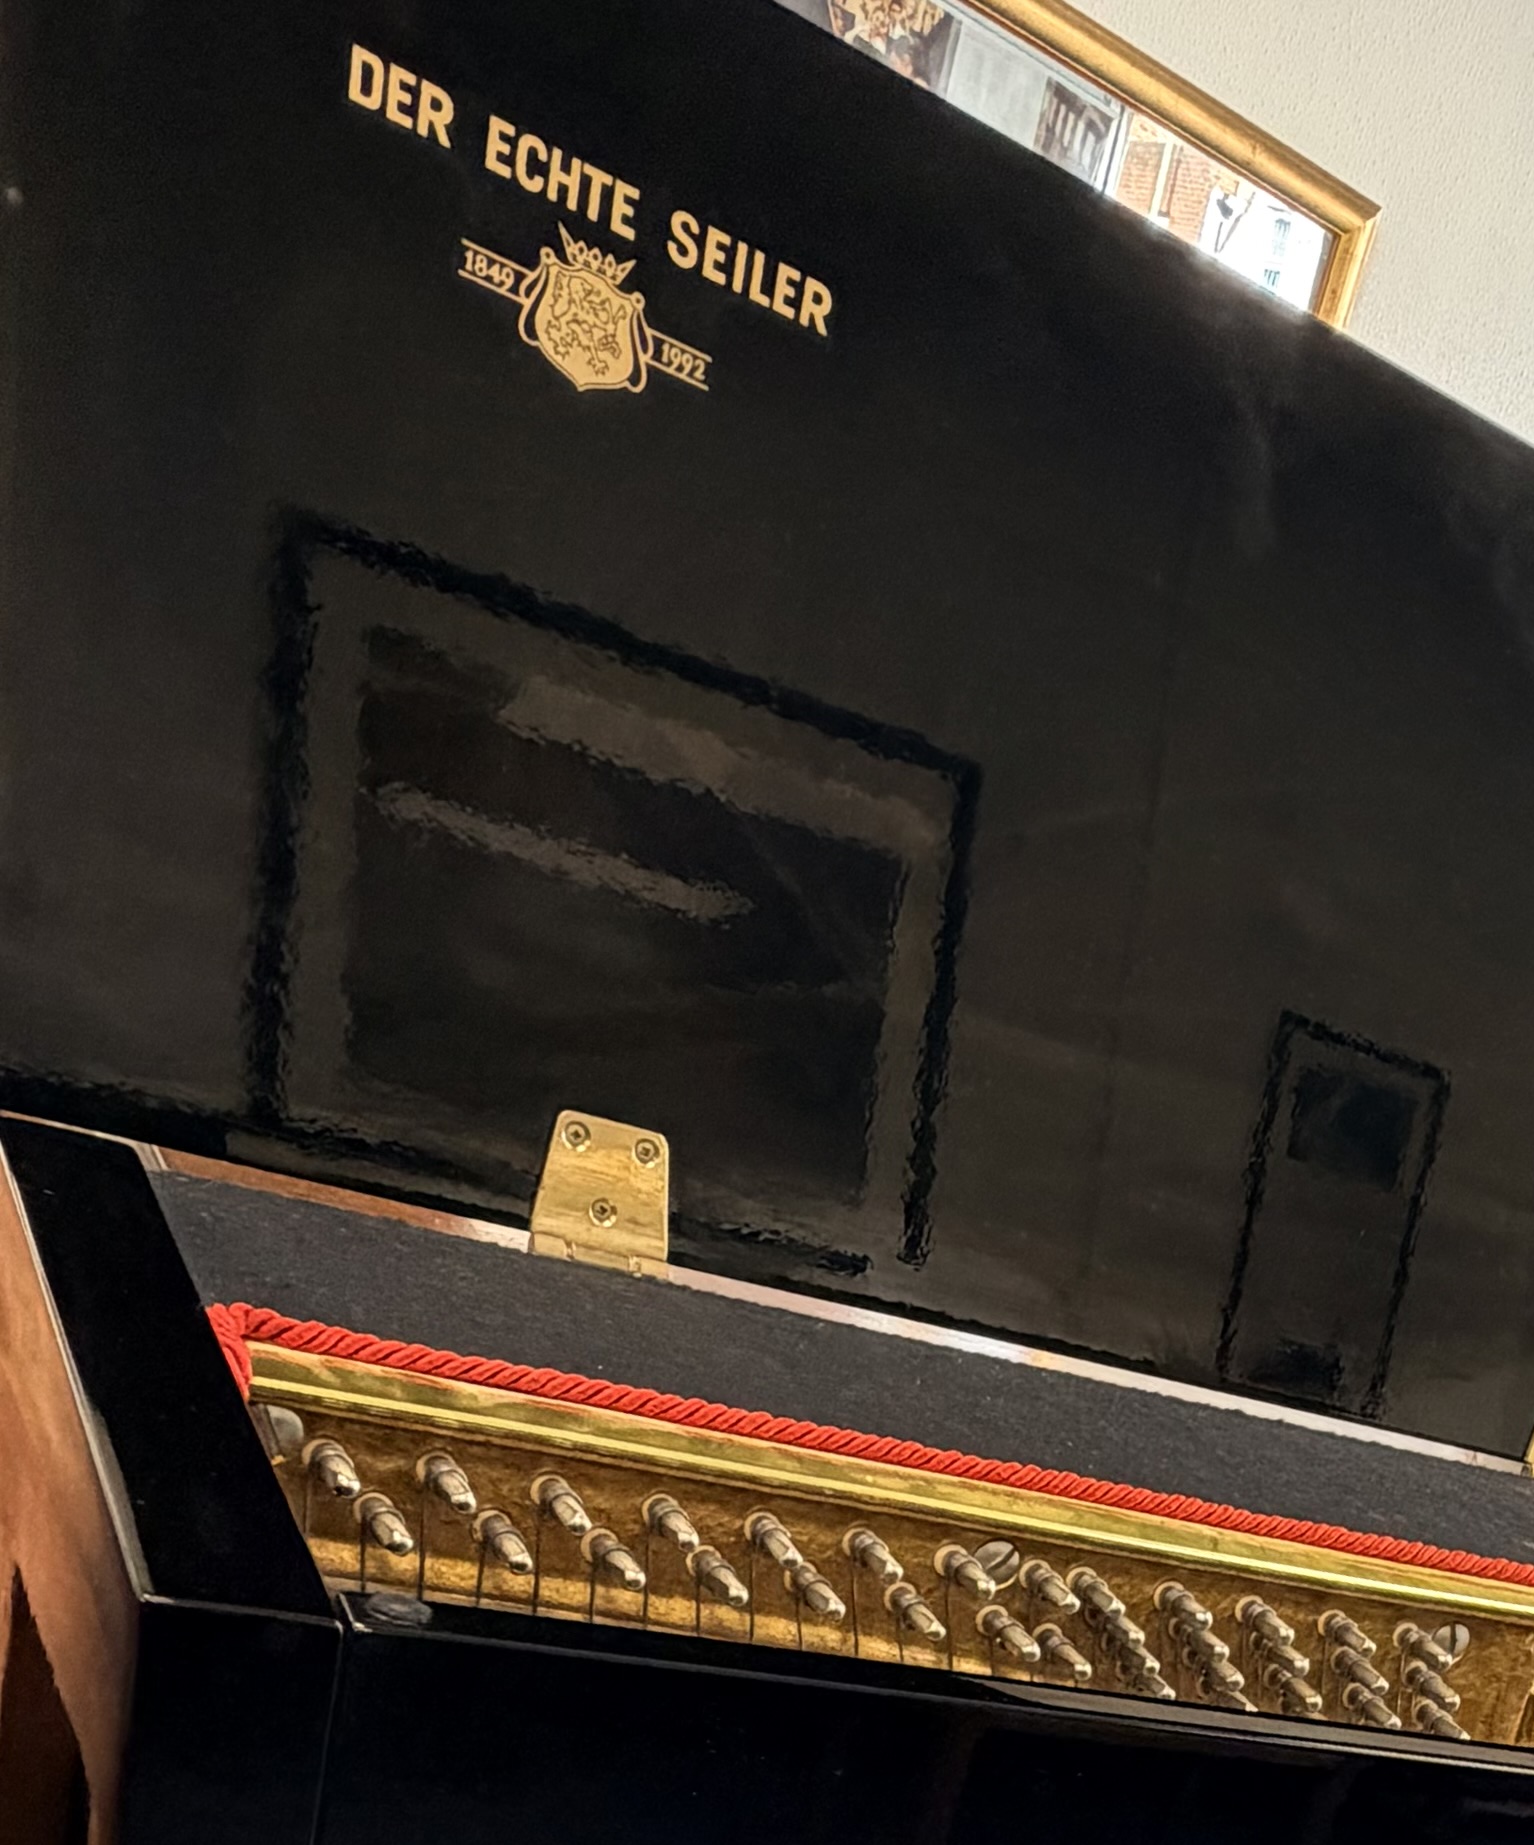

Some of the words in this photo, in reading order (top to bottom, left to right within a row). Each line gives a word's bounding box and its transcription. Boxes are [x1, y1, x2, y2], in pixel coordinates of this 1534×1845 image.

[348, 43, 455, 149] DER
[484, 114, 641, 242] ECHTE
[666, 209, 834, 338] SEILER
[463, 249, 516, 288] 1849
[660, 342, 708, 382] 1992
